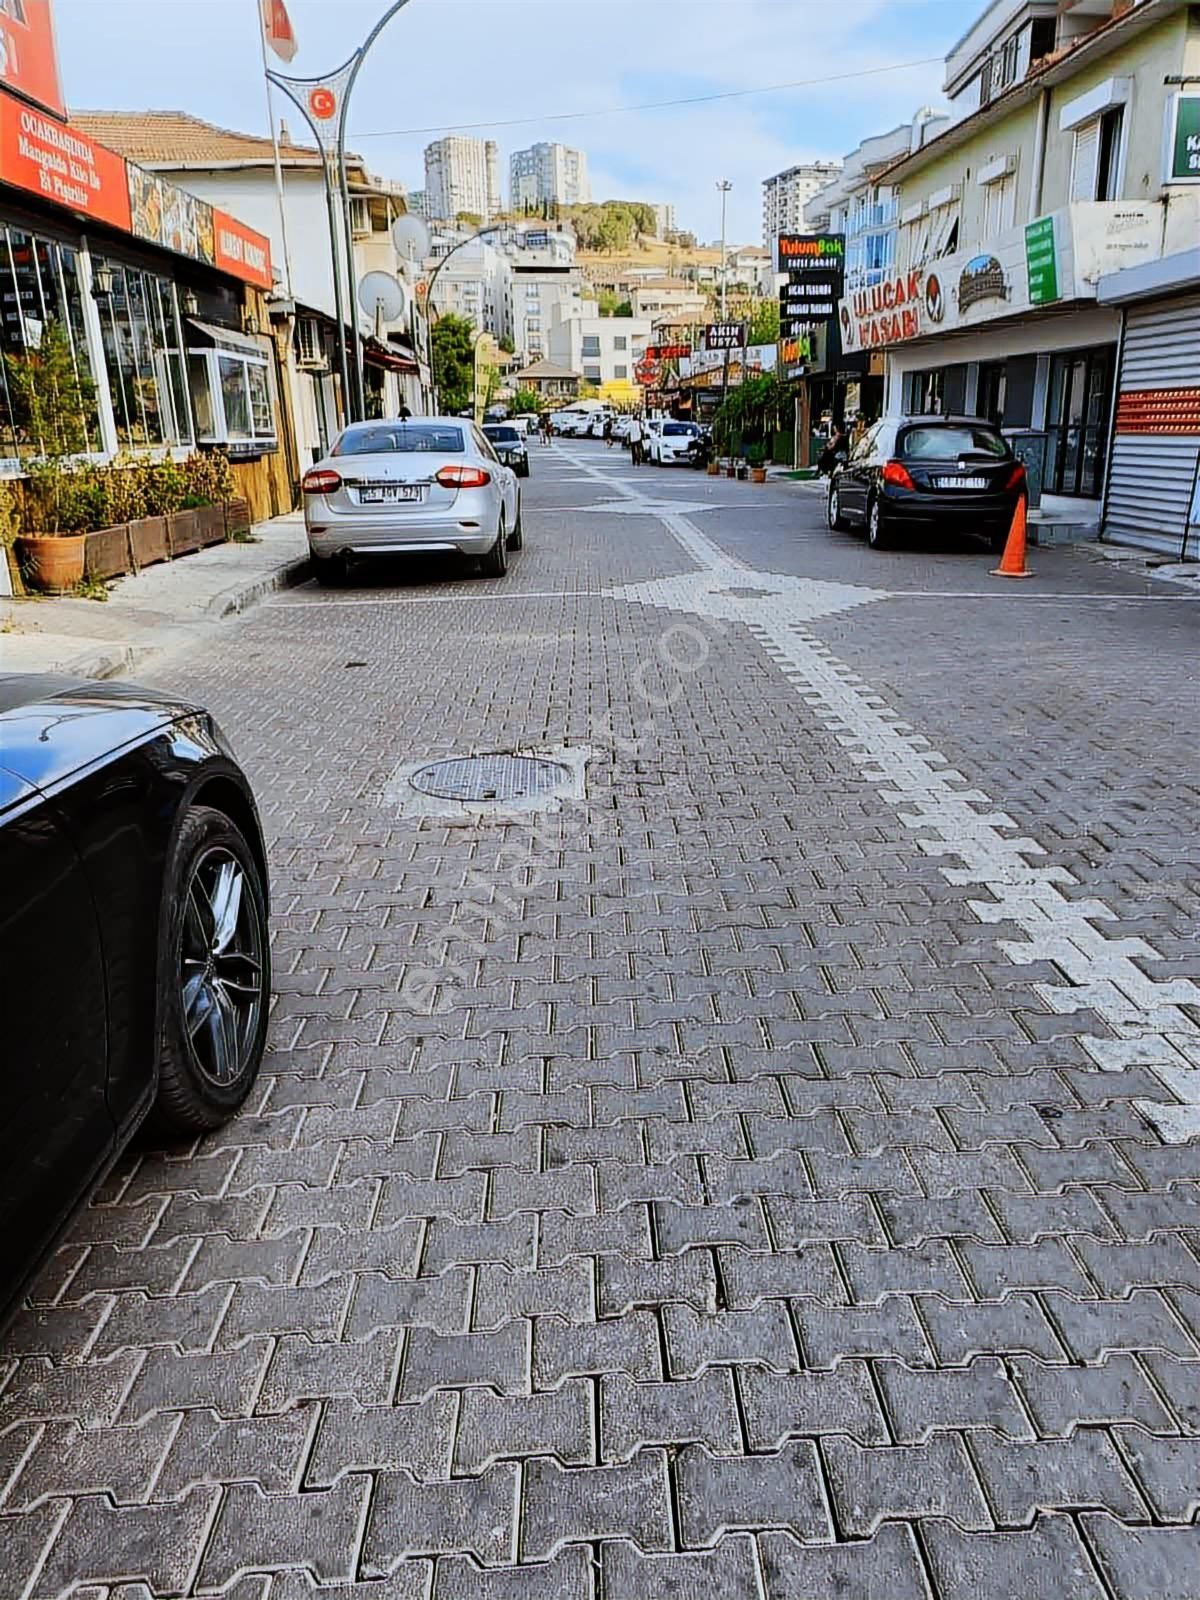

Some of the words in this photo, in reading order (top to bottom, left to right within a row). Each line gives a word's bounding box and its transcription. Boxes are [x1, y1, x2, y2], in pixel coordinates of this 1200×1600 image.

[780, 239, 843, 256] TulumBak
[853, 271, 923, 318] ULUCAK
[709, 326, 739, 336] AKIN
[710, 337, 739, 347] USTA
